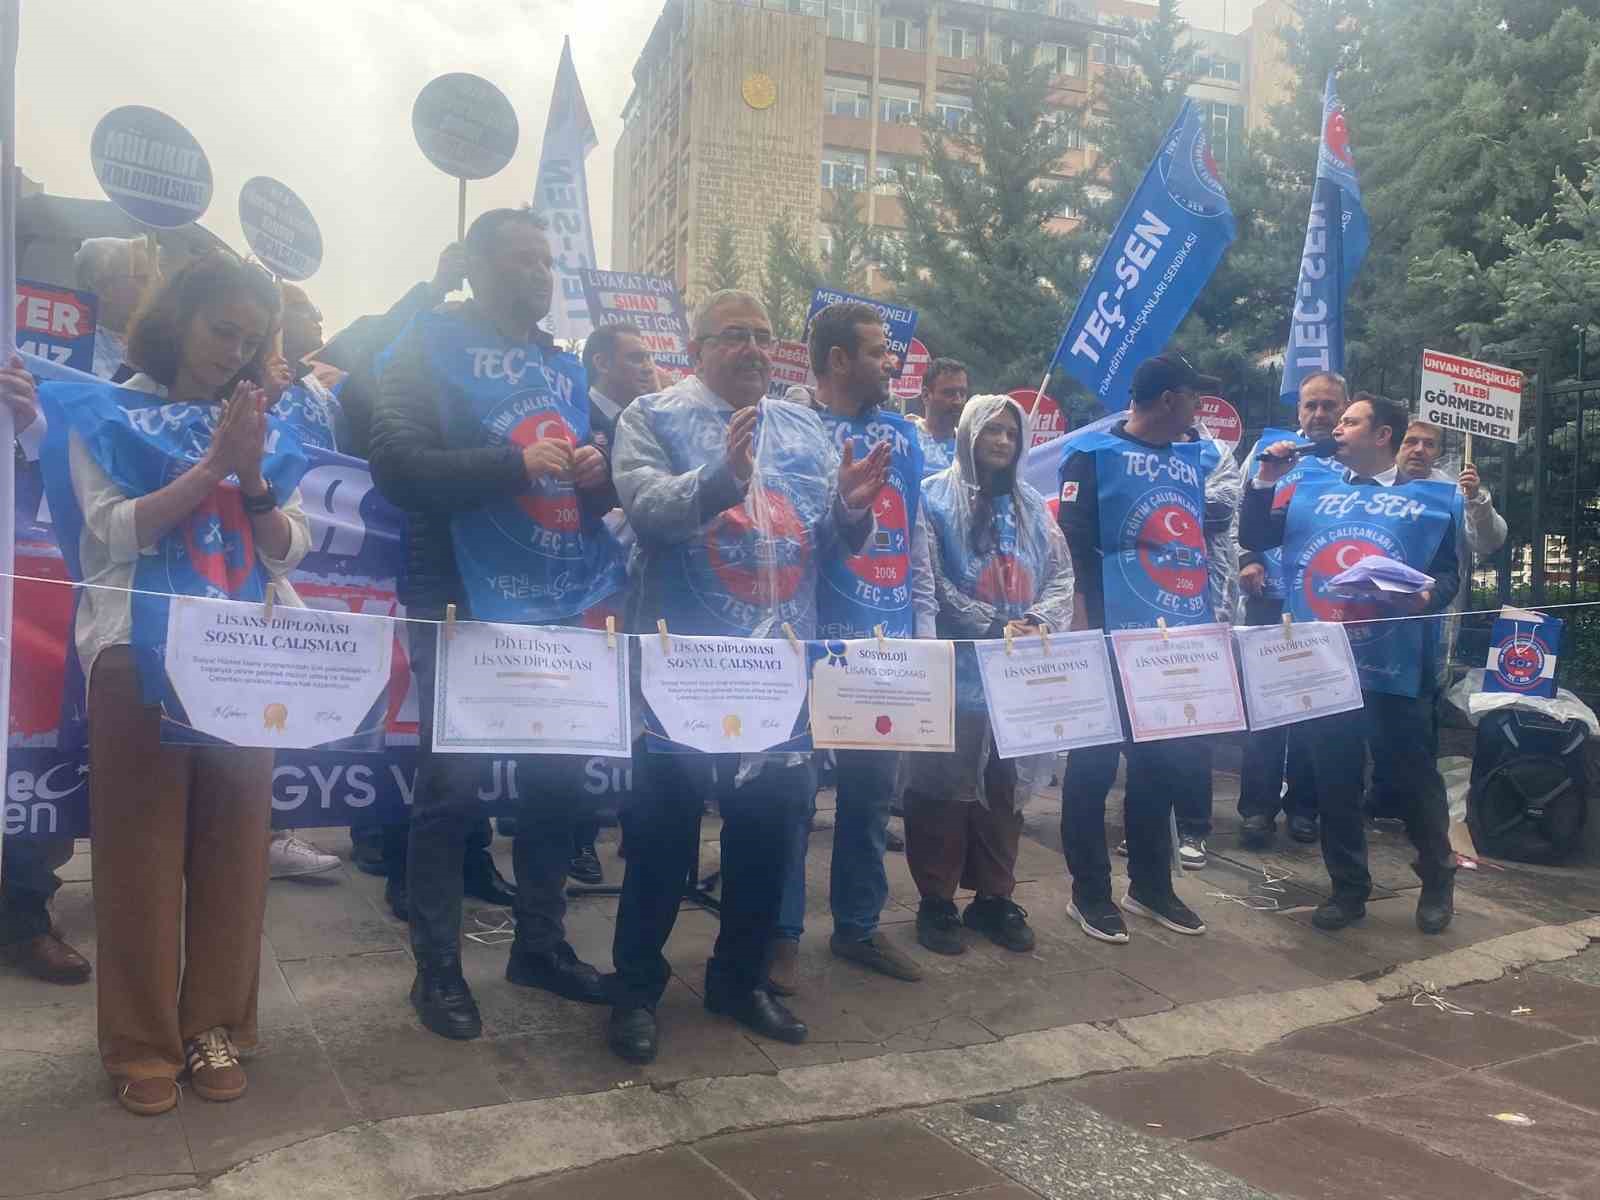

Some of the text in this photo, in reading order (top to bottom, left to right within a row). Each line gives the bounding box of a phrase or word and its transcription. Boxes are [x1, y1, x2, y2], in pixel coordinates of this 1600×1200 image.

[1070, 209, 1171, 364] TEÇ-SEN
[1424, 358, 1460, 375] UNVAN
[1425, 389, 1514, 421] GÖRMEZDEN
[1454, 382, 1490, 400] TALEBİ
[1429, 410, 1511, 439] GELİNEMEZ!
[1122, 451, 1200, 489] TEÇ-SEN
[1315, 490, 1427, 522] TEÇ-SEN
[204, 630, 268, 647] SOSYAL
[271, 764, 377, 811] GYS
